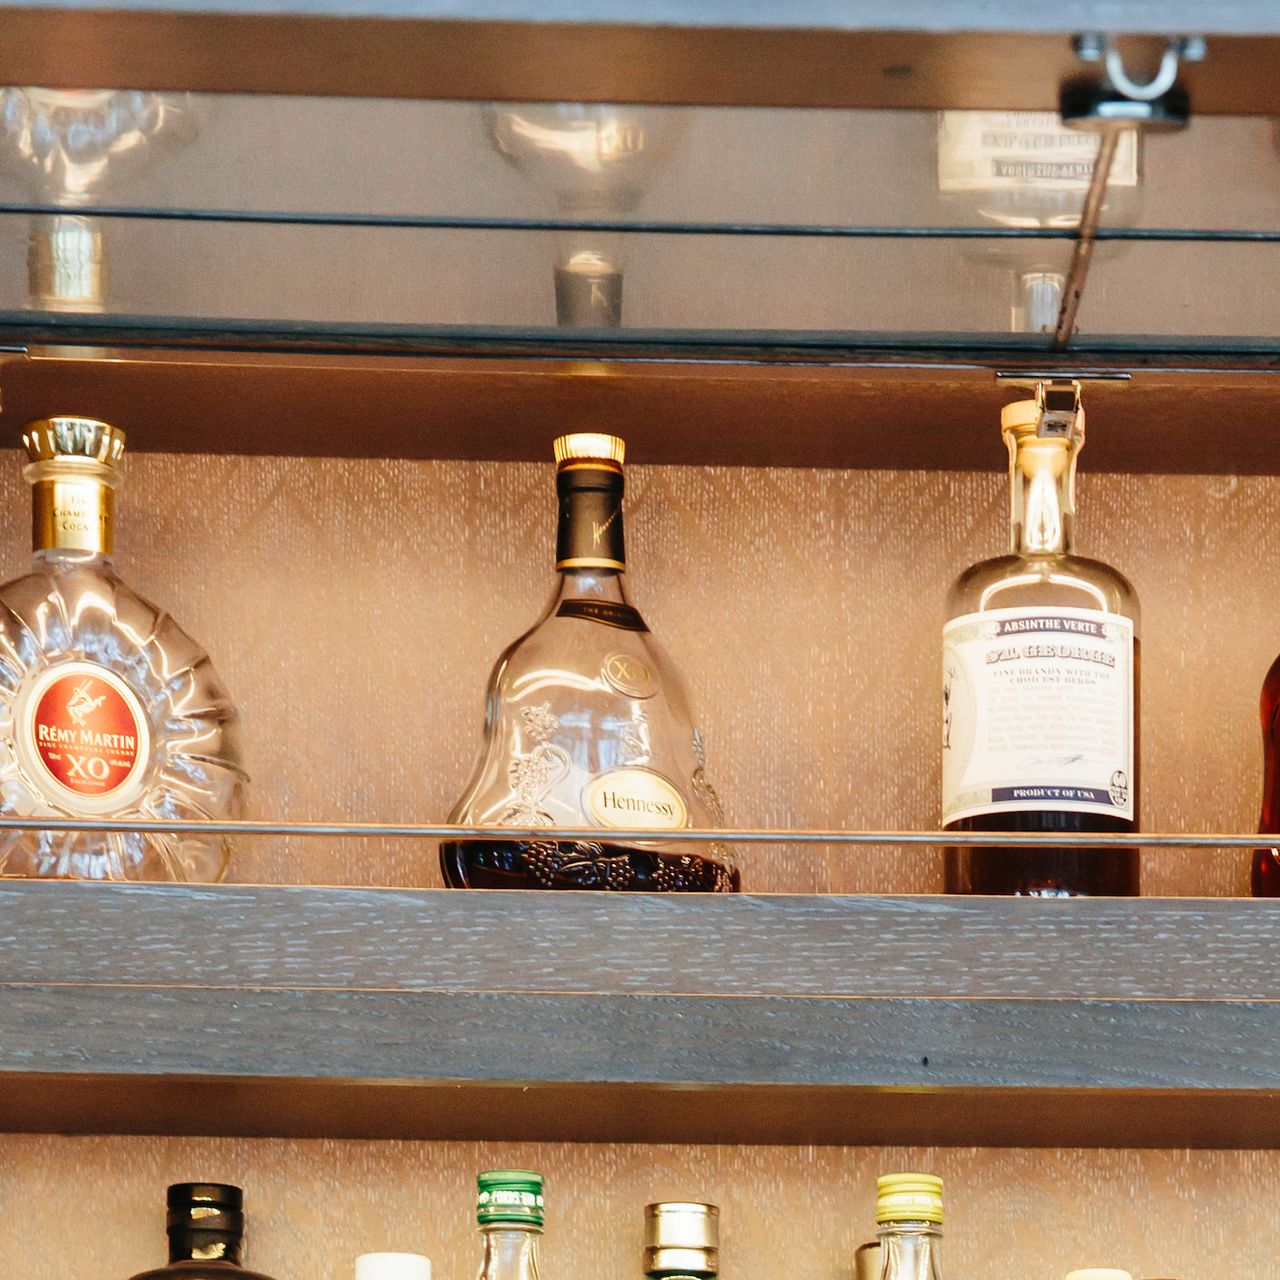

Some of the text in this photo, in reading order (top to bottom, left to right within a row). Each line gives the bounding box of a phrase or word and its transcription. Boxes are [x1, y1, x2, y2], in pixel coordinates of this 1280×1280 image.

[1003, 619, 1098, 634] ABSINTHE VERTE
[38, 723, 136, 750] RÉMY MARTIN
[66, 753, 110, 780] XO
[602, 791, 676, 820] Hennessy
[1013, 788, 1095, 799] PRODUCT OF USA
